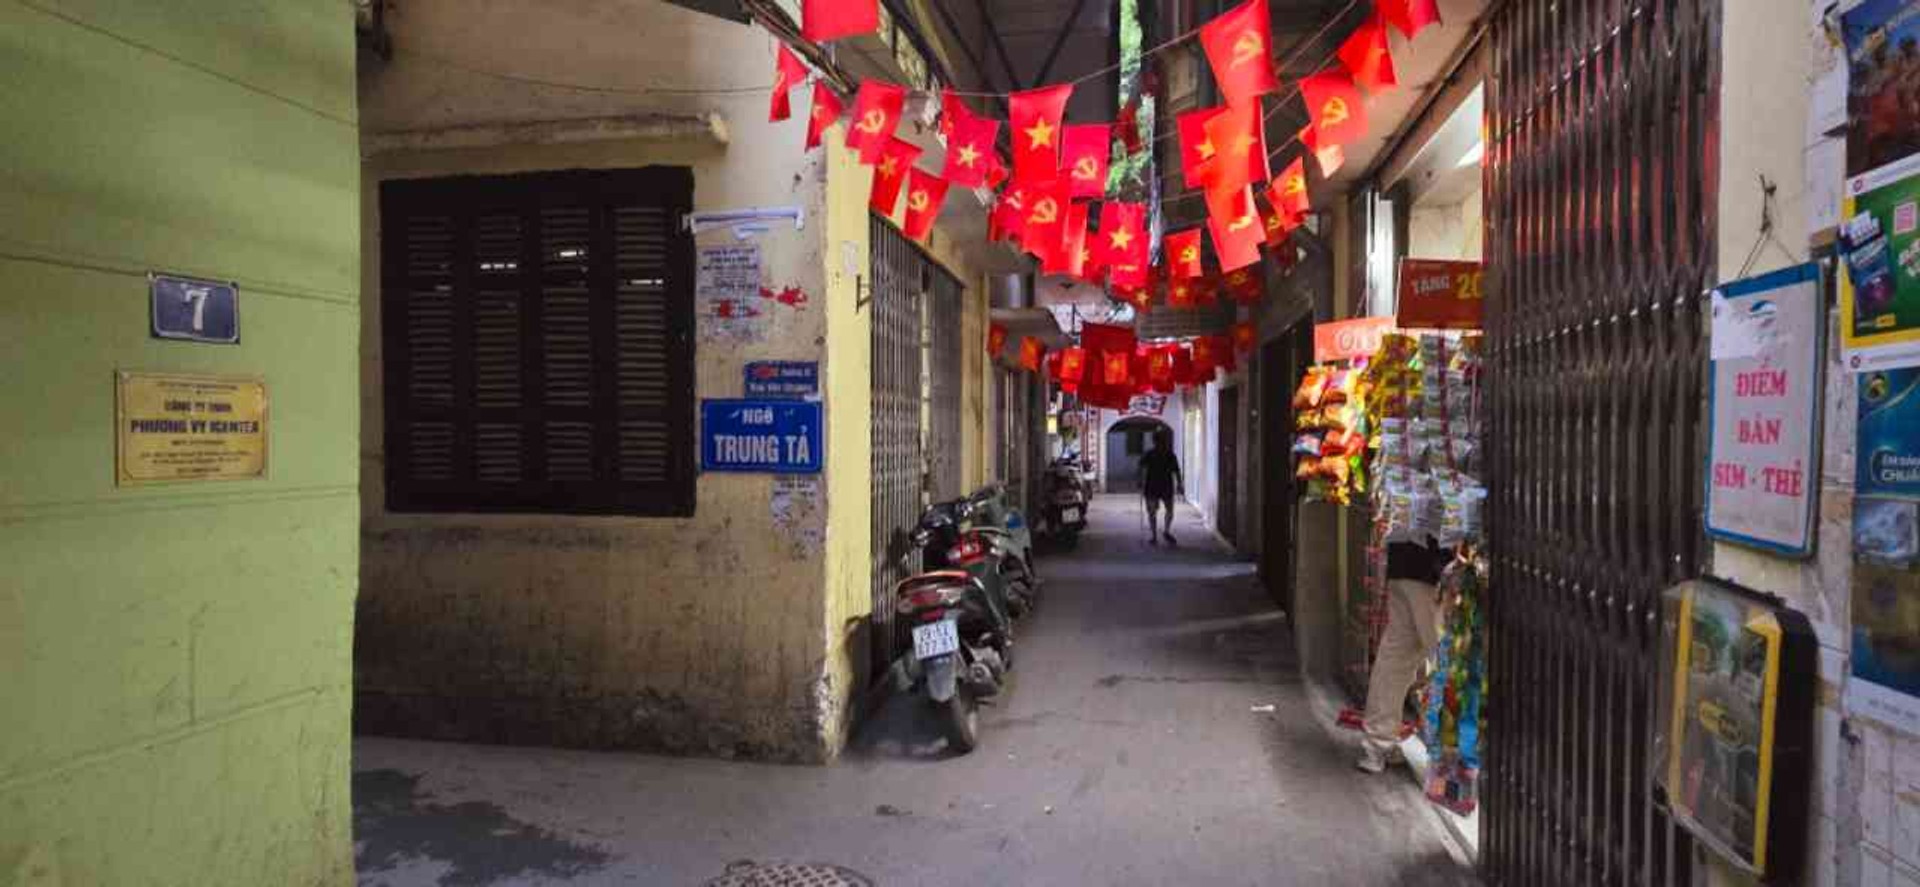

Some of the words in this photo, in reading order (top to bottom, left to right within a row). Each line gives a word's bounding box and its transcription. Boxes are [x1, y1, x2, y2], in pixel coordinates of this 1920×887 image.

[184, 287, 209, 331] 7
[1736, 356, 1787, 397] ĐIỂM
[741, 406, 774, 425] NGÕ
[713, 434, 780, 464] TRUNG
[784, 424, 811, 464] TẢ
[1714, 462, 1746, 489] SIM
[1761, 458, 1804, 497] THẺ
